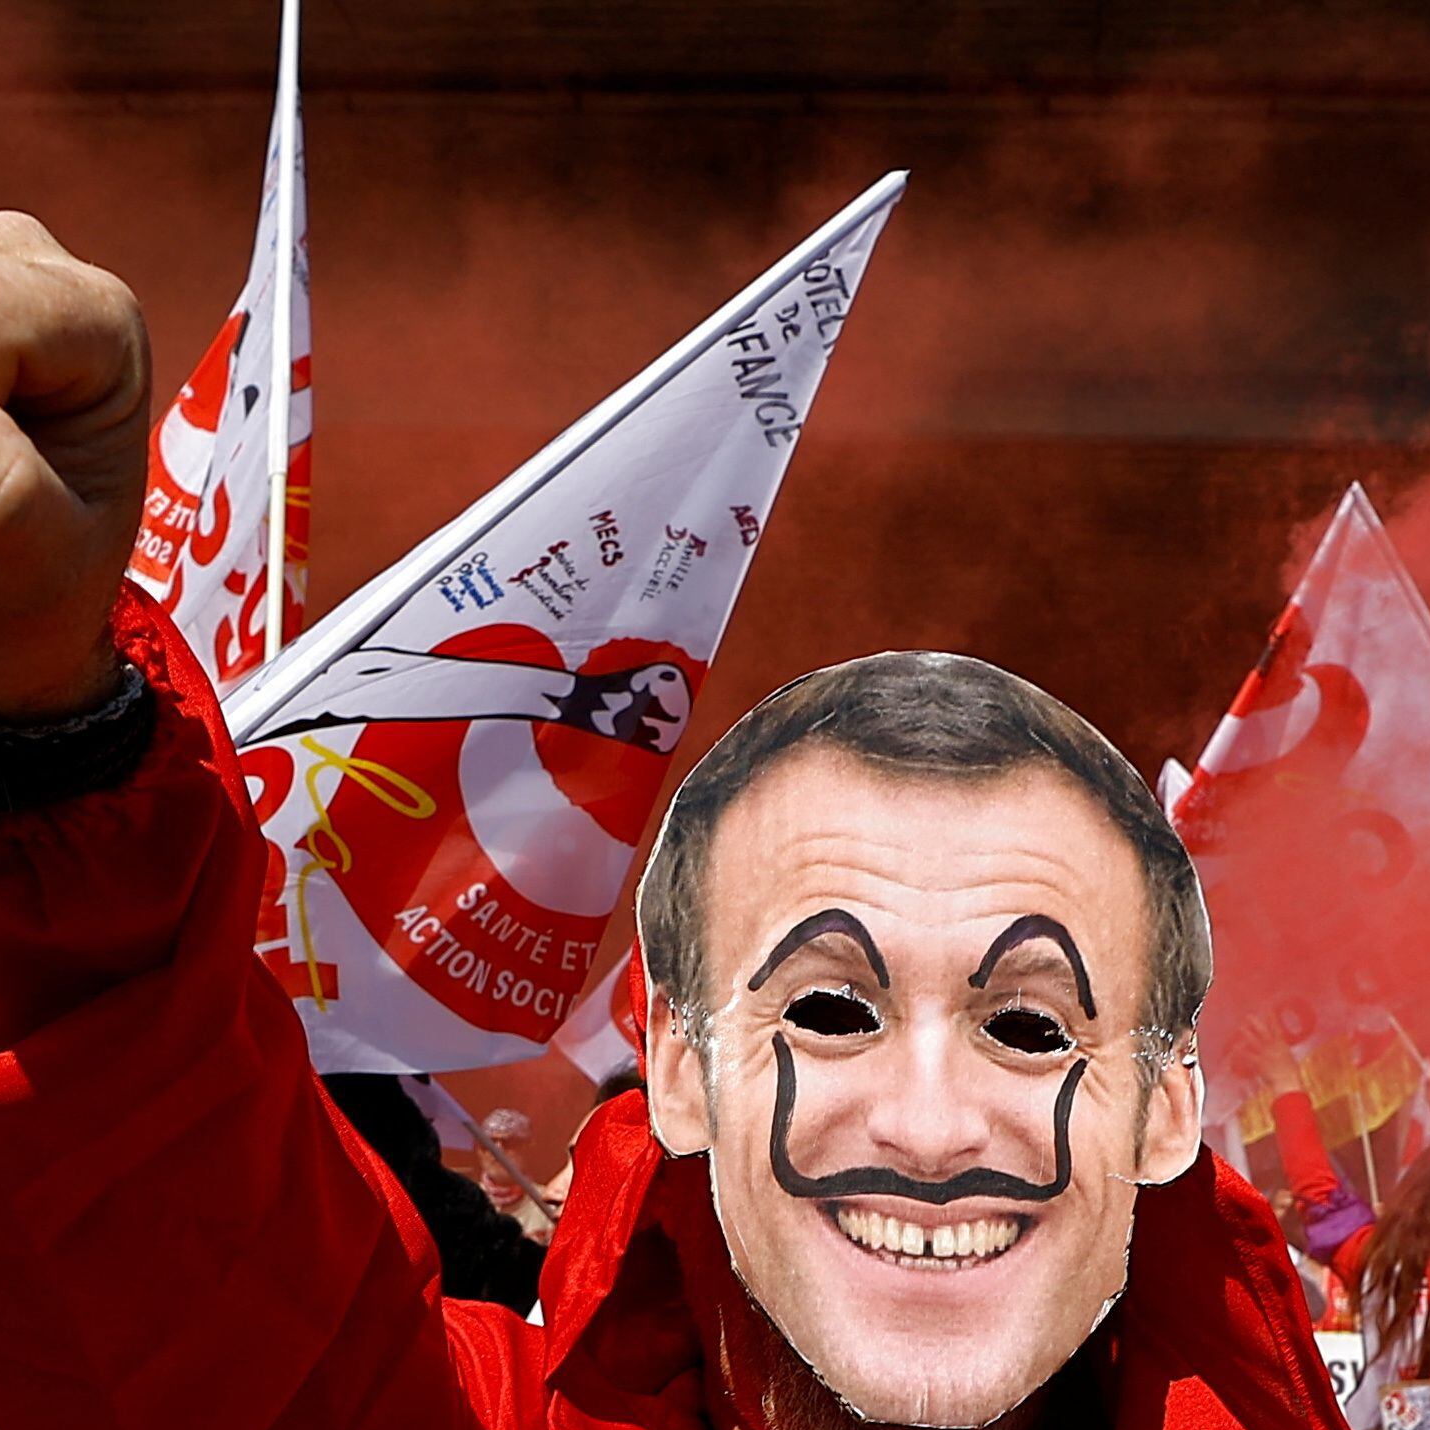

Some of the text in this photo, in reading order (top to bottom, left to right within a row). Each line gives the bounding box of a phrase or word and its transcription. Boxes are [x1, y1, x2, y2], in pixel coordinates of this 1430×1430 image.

[727, 321, 802, 447] FANCE
[589, 510, 623, 566] MECS
[299, 734, 437, 1014] la
[394, 904, 493, 995] ACTION
[457, 881, 597, 971] SANTÉ ET
